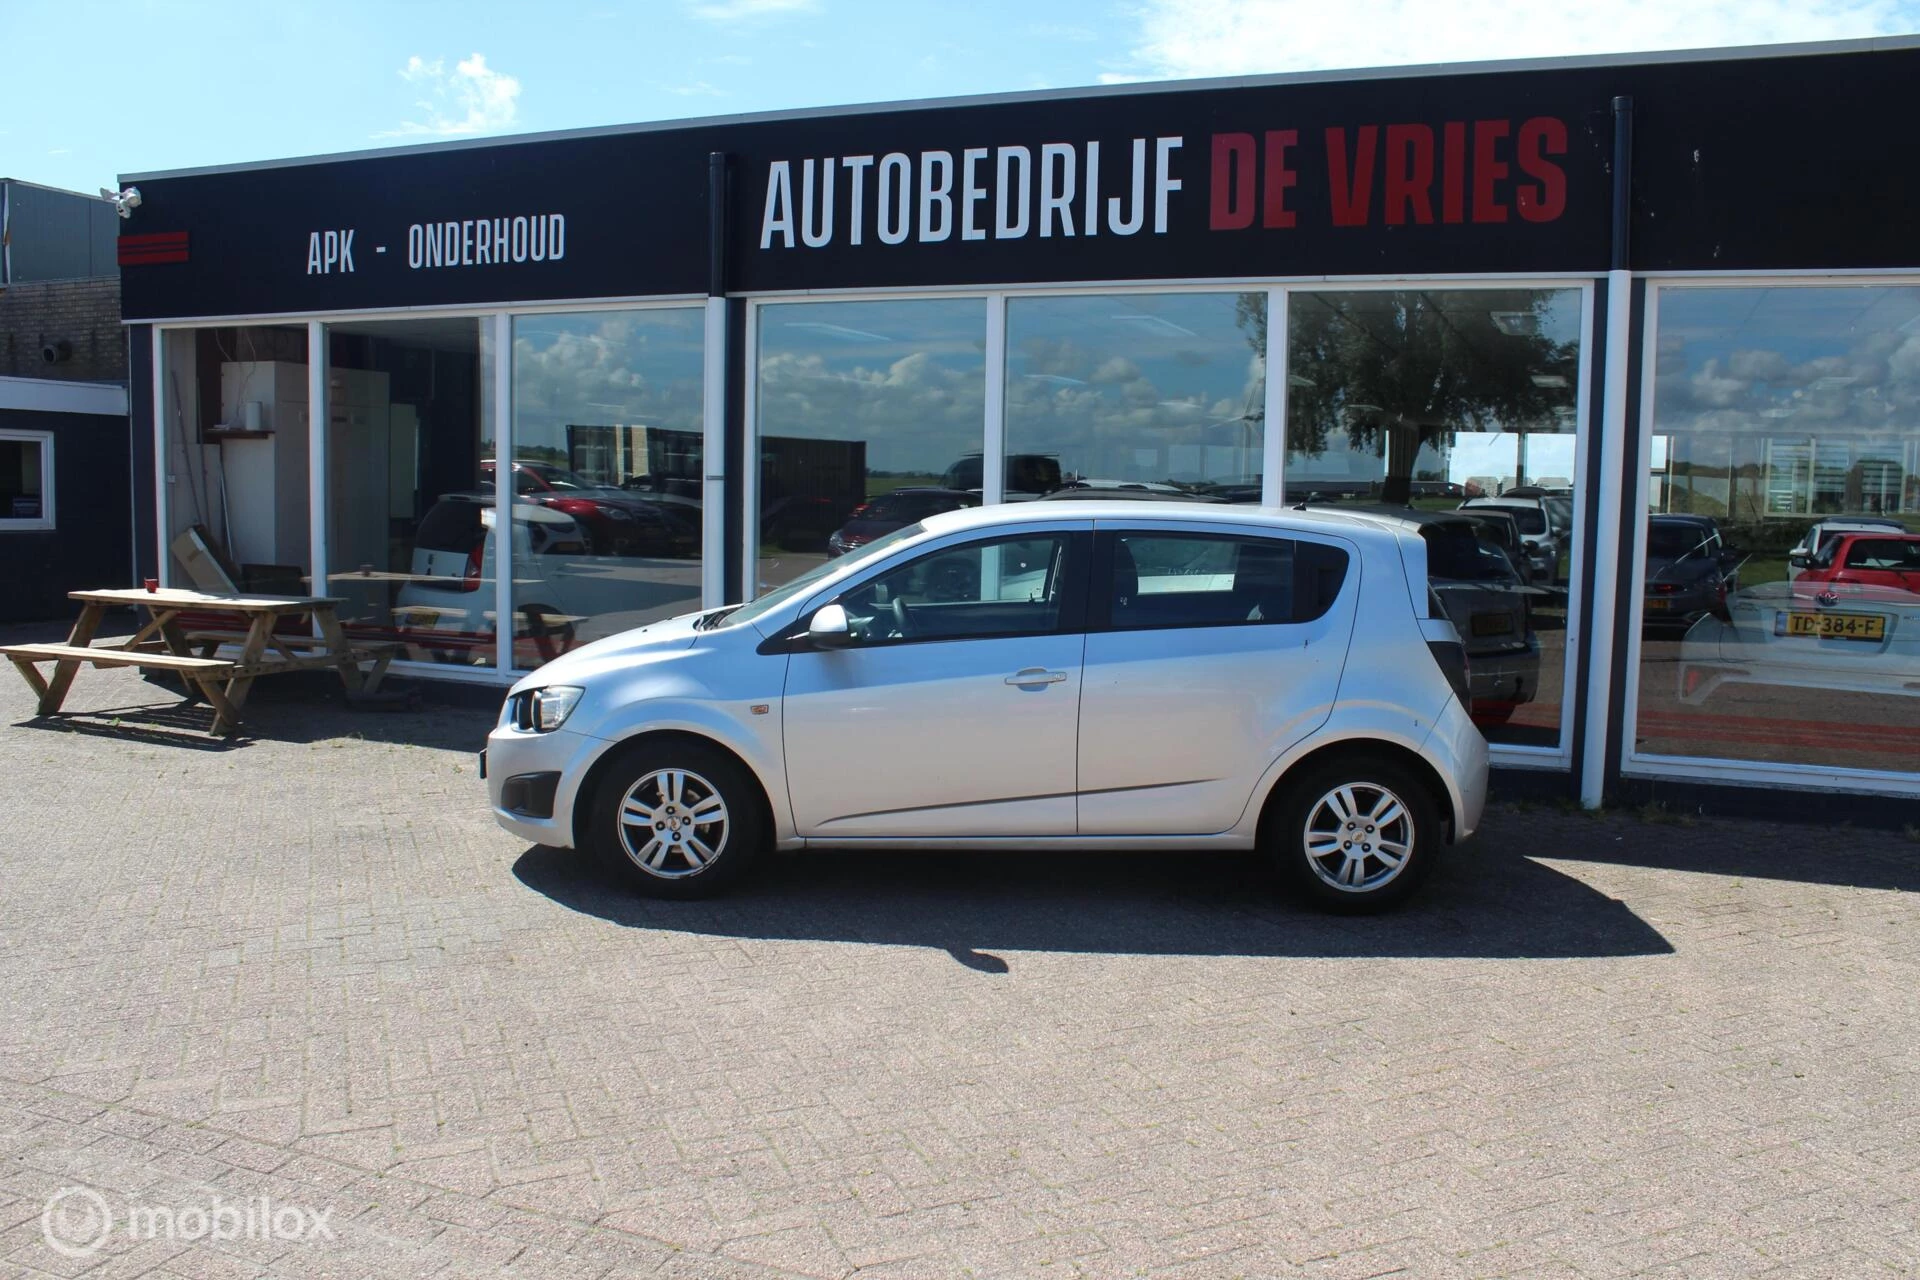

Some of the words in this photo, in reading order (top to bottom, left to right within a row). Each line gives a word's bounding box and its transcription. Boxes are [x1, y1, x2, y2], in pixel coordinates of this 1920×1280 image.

[760, 136, 1184, 249] AUTOBEDRIJF
[1209, 130, 1298, 231] DE
[1324, 116, 1568, 228] VRIES
[307, 229, 355, 275] APK
[408, 213, 565, 269] ONDERHOUD
[1793, 615, 1876, 634] TD-384-F
